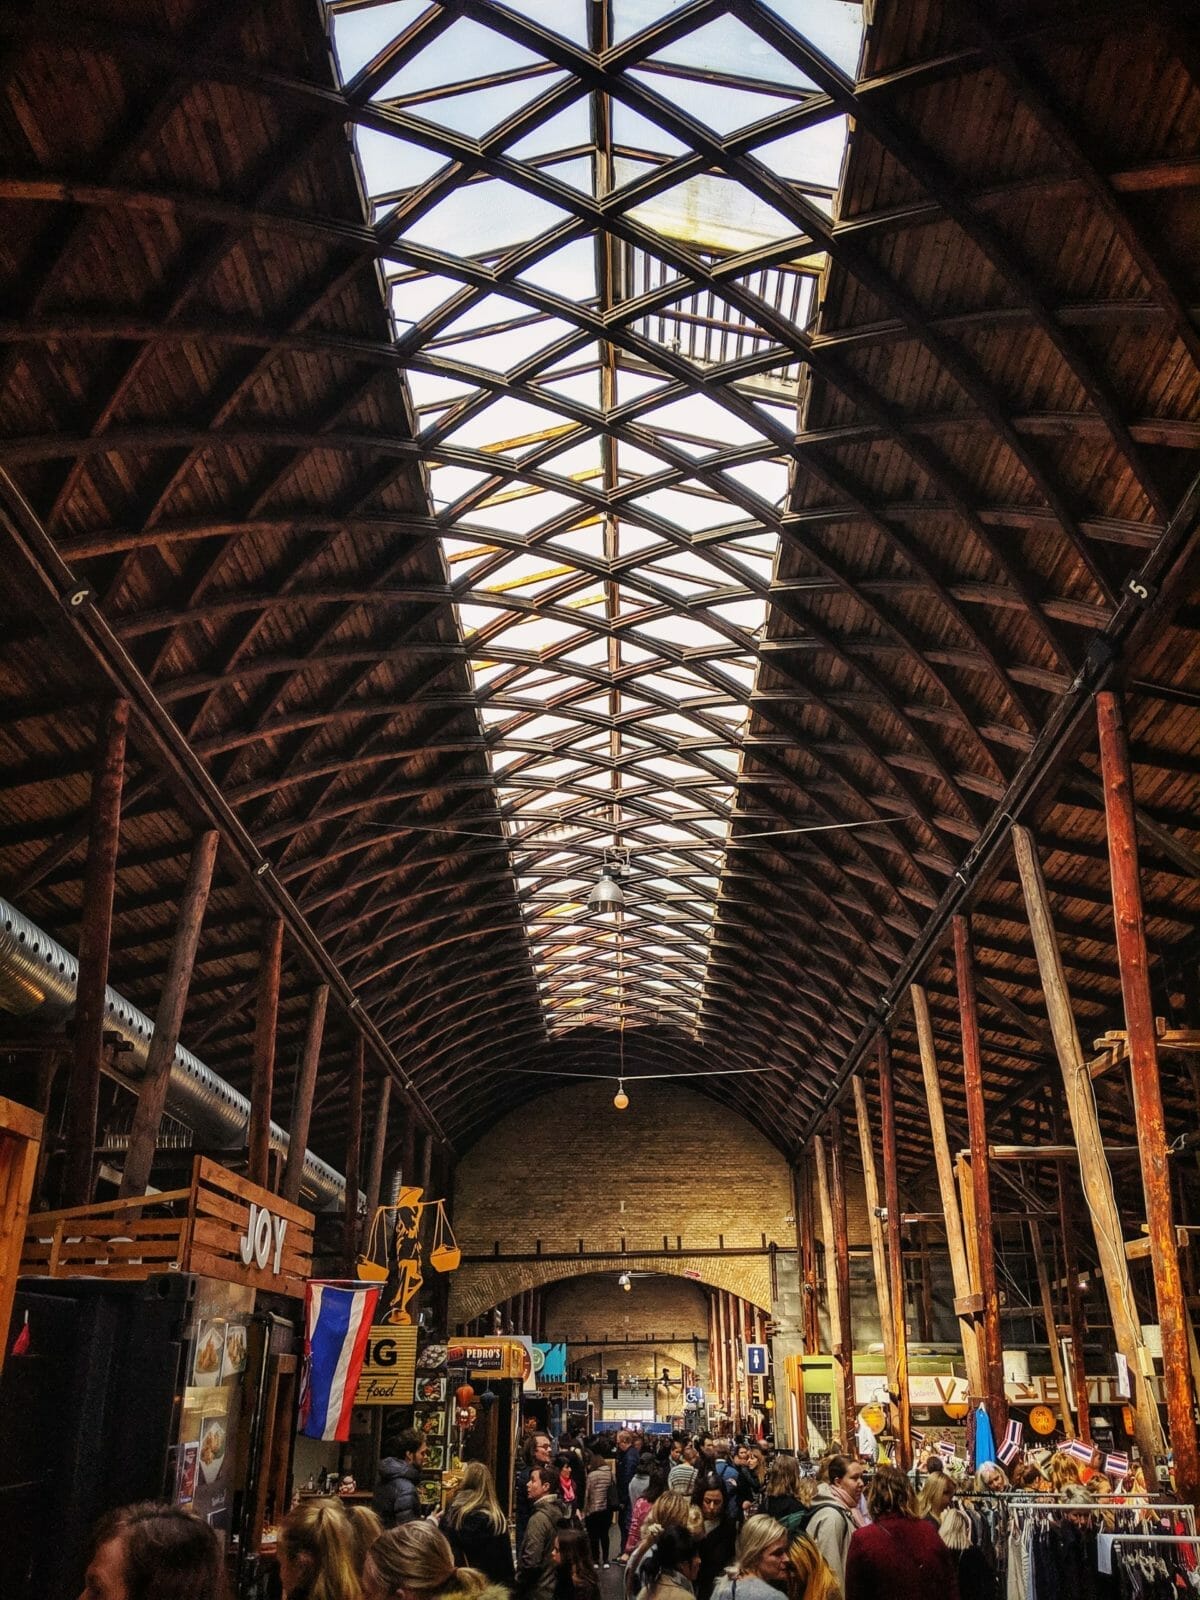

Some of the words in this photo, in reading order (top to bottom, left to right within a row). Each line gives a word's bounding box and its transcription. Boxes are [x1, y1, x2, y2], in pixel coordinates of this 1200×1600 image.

[1129, 580, 1148, 599] 5
[240, 1203, 288, 1275] JOY
[466, 1348, 501, 1359] PEDRO'S
[366, 1378, 398, 1401] food
